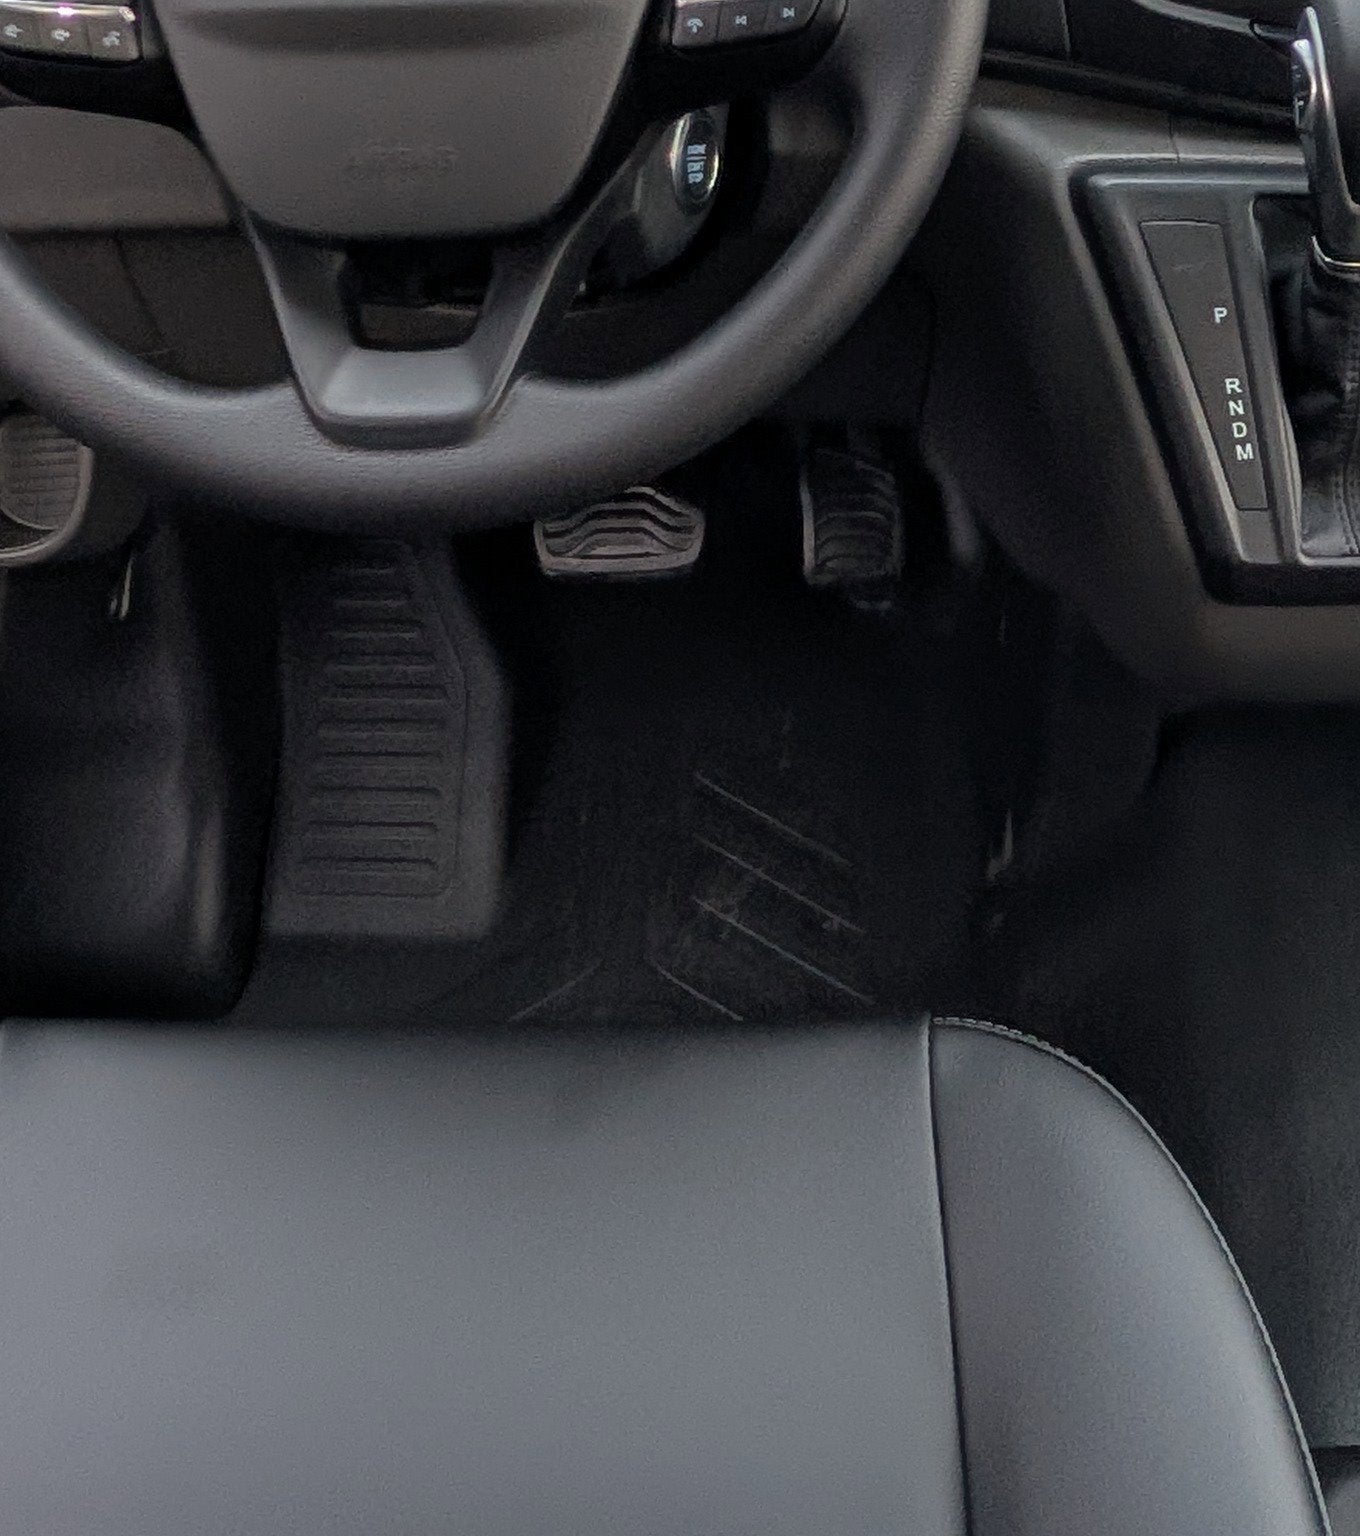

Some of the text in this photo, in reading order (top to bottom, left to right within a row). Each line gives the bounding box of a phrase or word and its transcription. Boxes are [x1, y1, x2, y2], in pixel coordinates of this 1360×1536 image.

[1213, 307, 1228, 324] P
[1224, 378, 1243, 395] R
[1228, 400, 1245, 416] N
[1232, 422, 1248, 439] D
[1235, 443, 1254, 461] M
